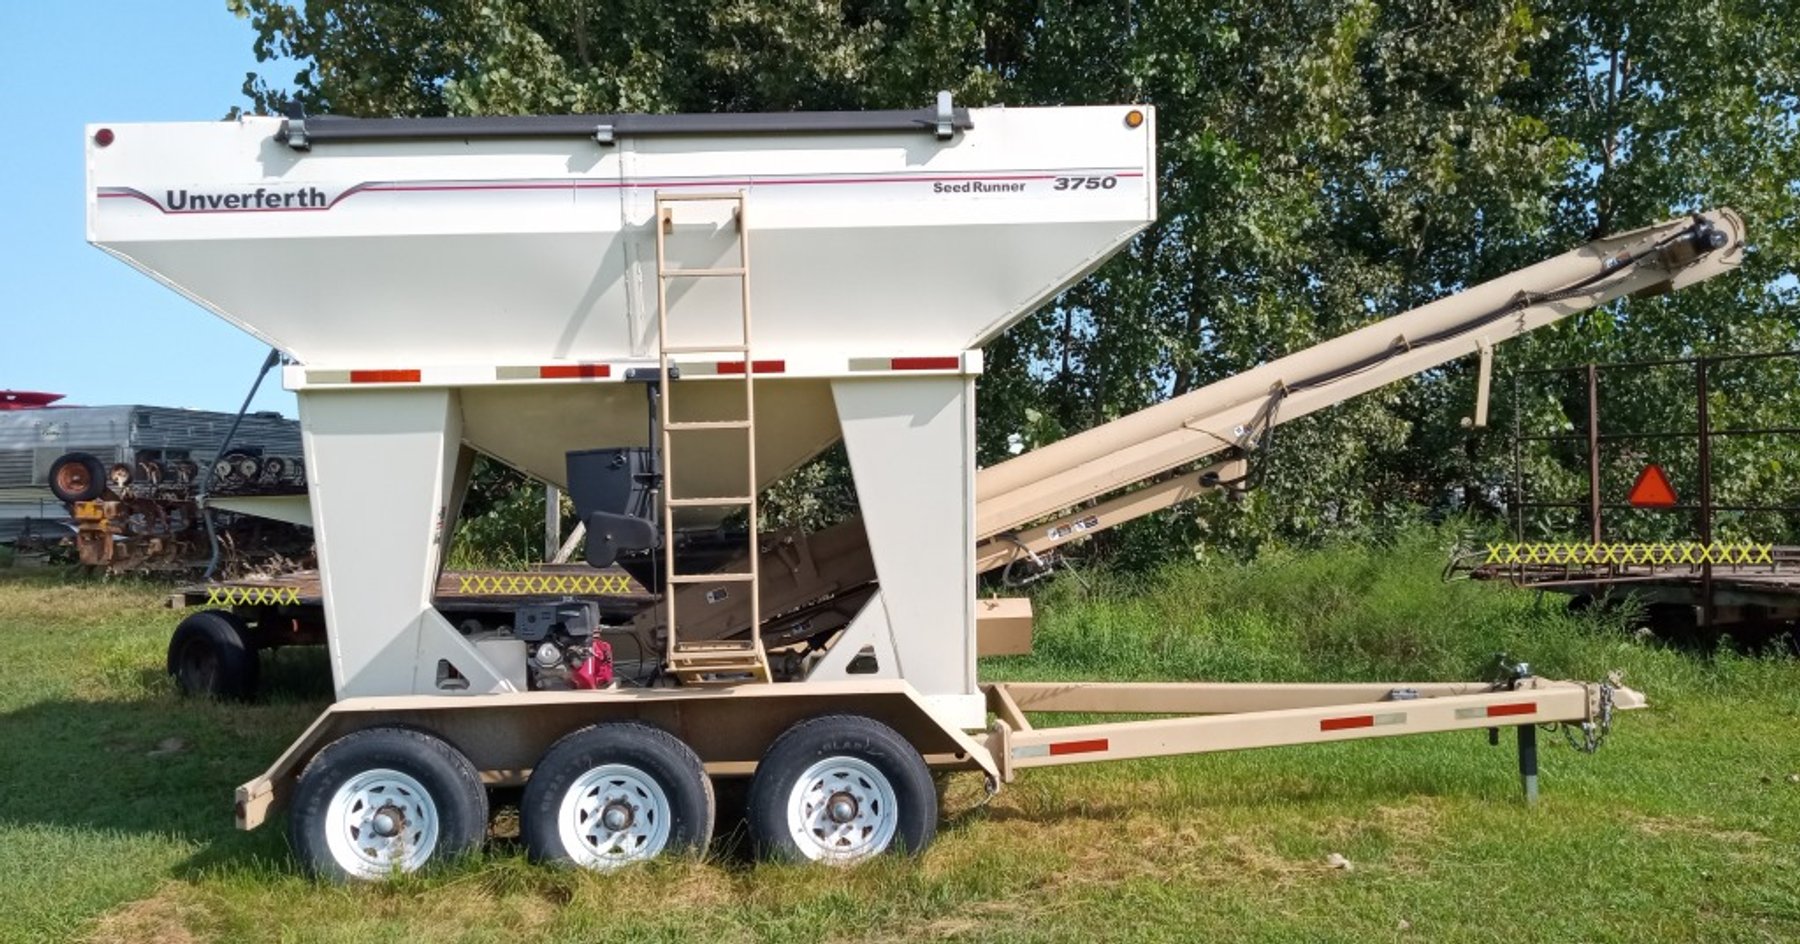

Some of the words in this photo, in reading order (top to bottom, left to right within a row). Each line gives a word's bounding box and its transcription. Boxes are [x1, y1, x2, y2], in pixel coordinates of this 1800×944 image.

[933, 181, 970, 193] Seed
[973, 181, 1026, 193] Runner
[1053, 176, 1117, 190] 3750
[166, 187, 326, 210] Unverferth
